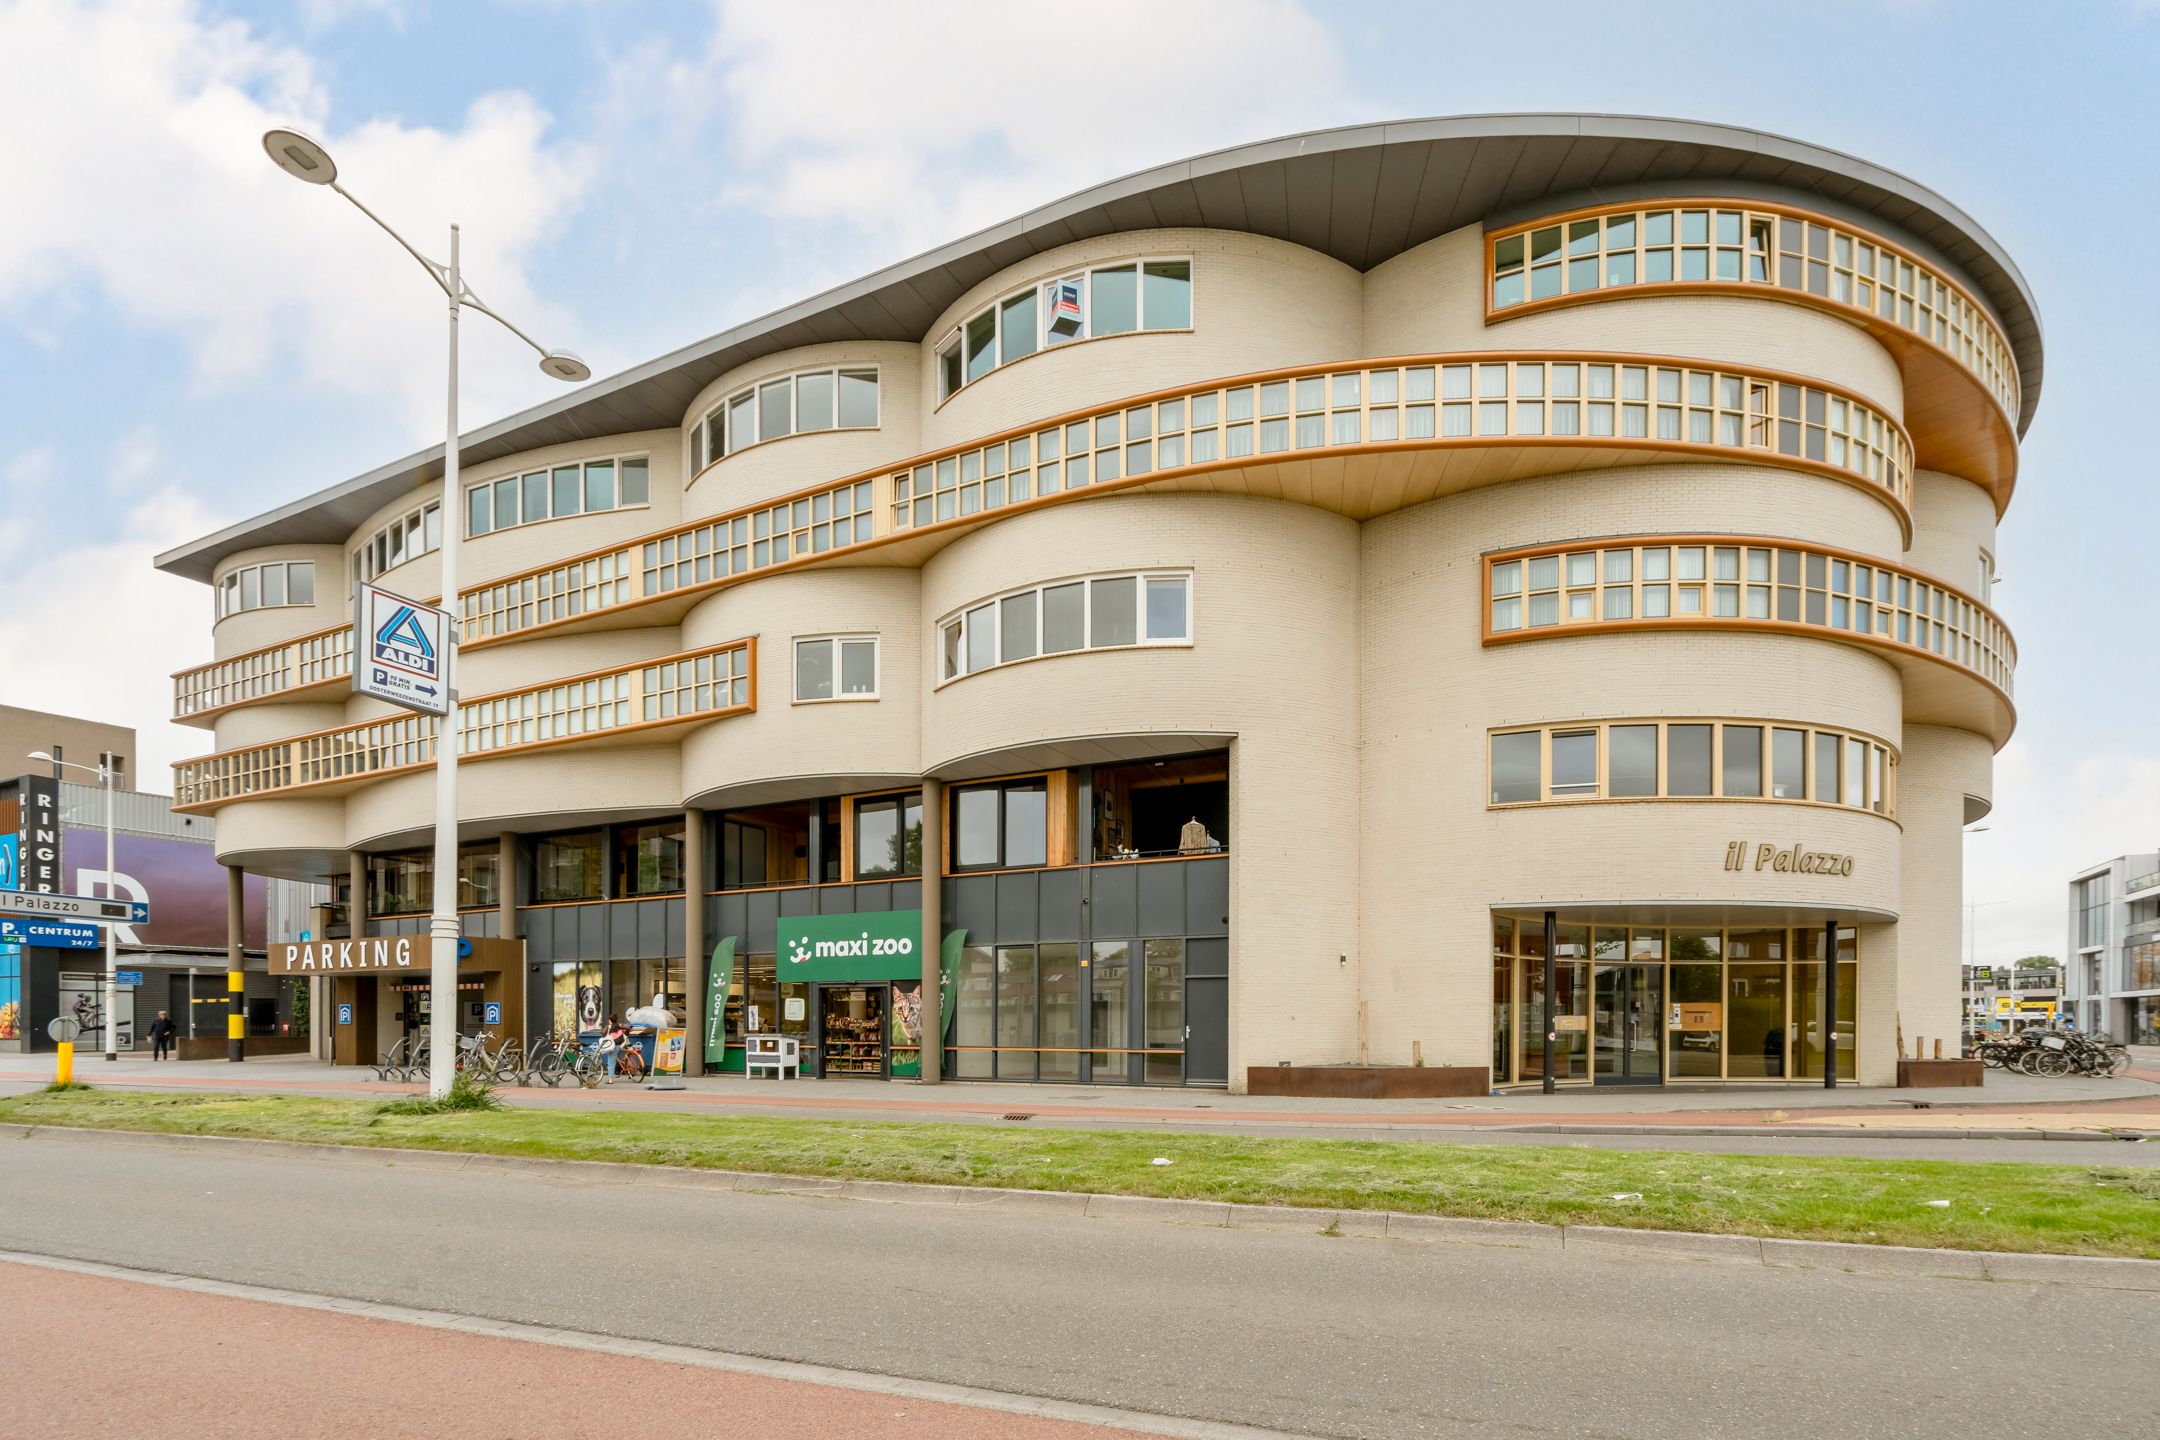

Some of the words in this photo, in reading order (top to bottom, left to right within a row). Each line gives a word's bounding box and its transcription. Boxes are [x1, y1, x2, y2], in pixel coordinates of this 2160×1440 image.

[381, 647, 429, 672] ALDI
[376, 671, 385, 682] P
[389, 680, 411, 690] GRATIS
[36, 793, 54, 893] RINGER
[1725, 841, 1747, 870] il
[1755, 843, 1855, 876] Palazzo
[15, 896, 80, 912] Palazzo
[29, 926, 93, 937] CENTRUM
[286, 938, 410, 971] PARKING
[815, 931, 868, 957] maxi
[872, 937, 913, 956] zoo
[713, 993, 722, 1016] zoo
